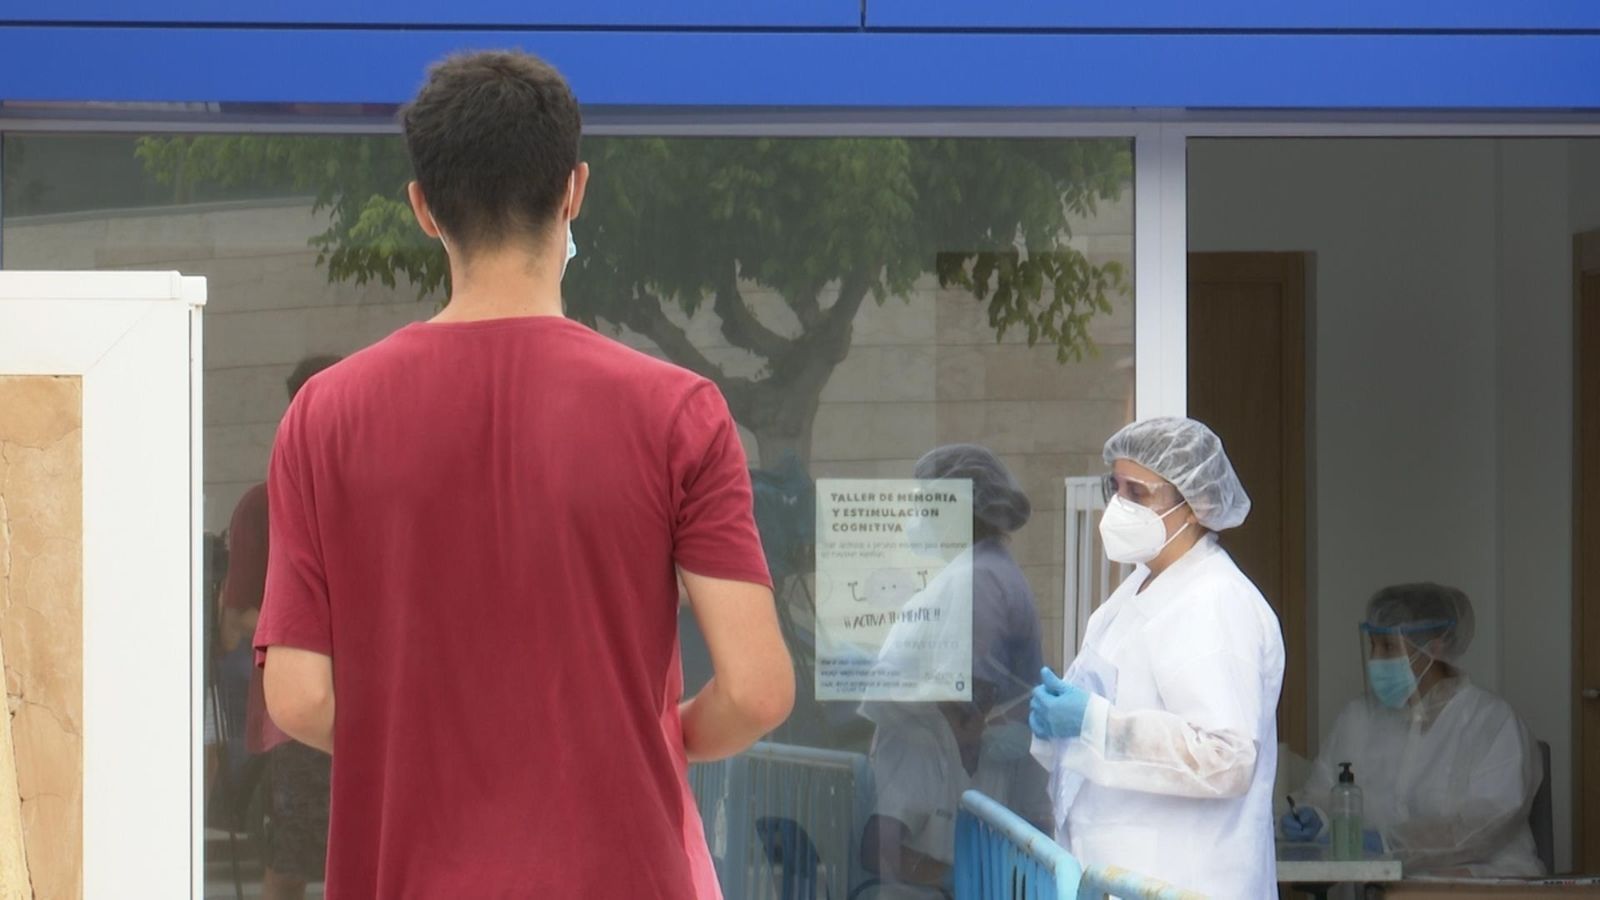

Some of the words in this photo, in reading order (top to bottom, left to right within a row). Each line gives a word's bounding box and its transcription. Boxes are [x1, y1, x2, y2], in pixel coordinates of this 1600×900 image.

[830, 492, 876, 503] TALLER
[879, 492, 894, 502] DE
[897, 492, 958, 503] MEMORIA
[831, 508, 840, 518] Y
[831, 522, 903, 533] COGNITIVA
